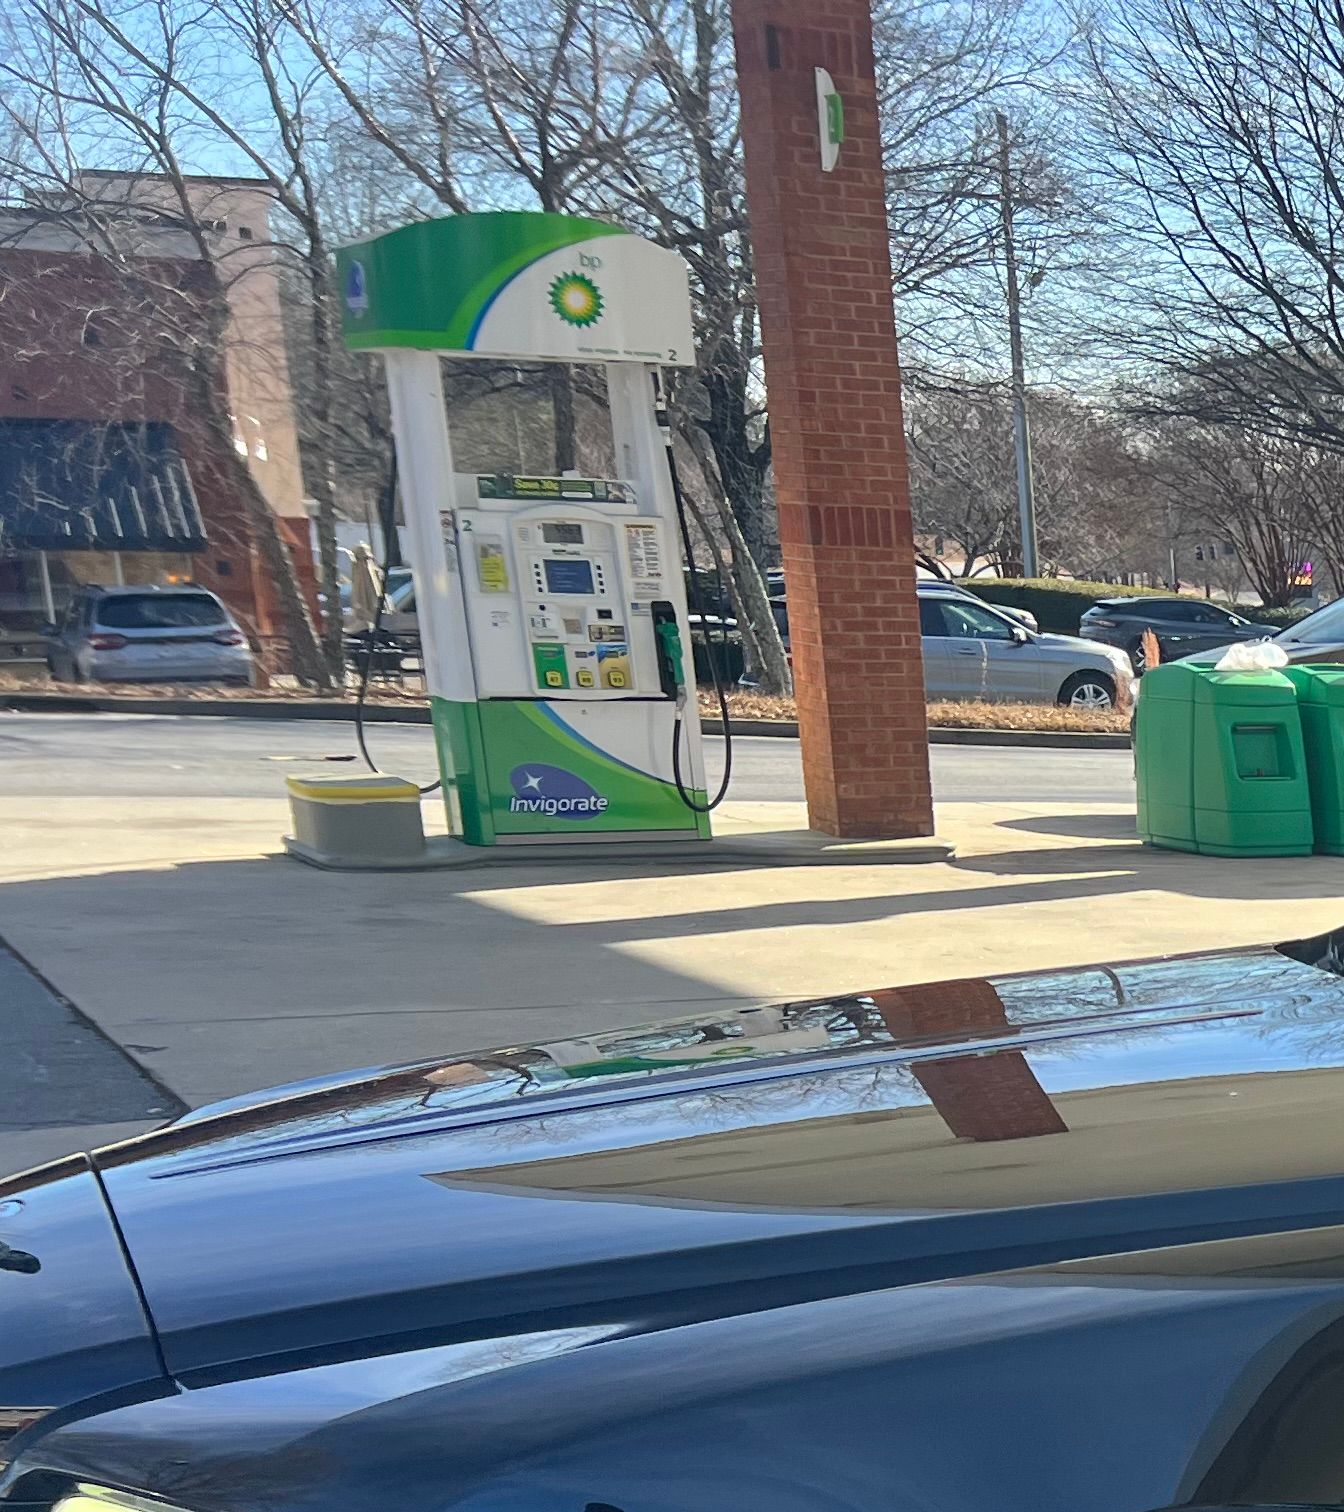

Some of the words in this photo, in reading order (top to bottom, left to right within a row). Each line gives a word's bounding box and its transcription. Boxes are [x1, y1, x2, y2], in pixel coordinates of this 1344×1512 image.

[578, 251, 602, 271] bp
[667, 349, 678, 362] 2
[462, 520, 473, 532] 2
